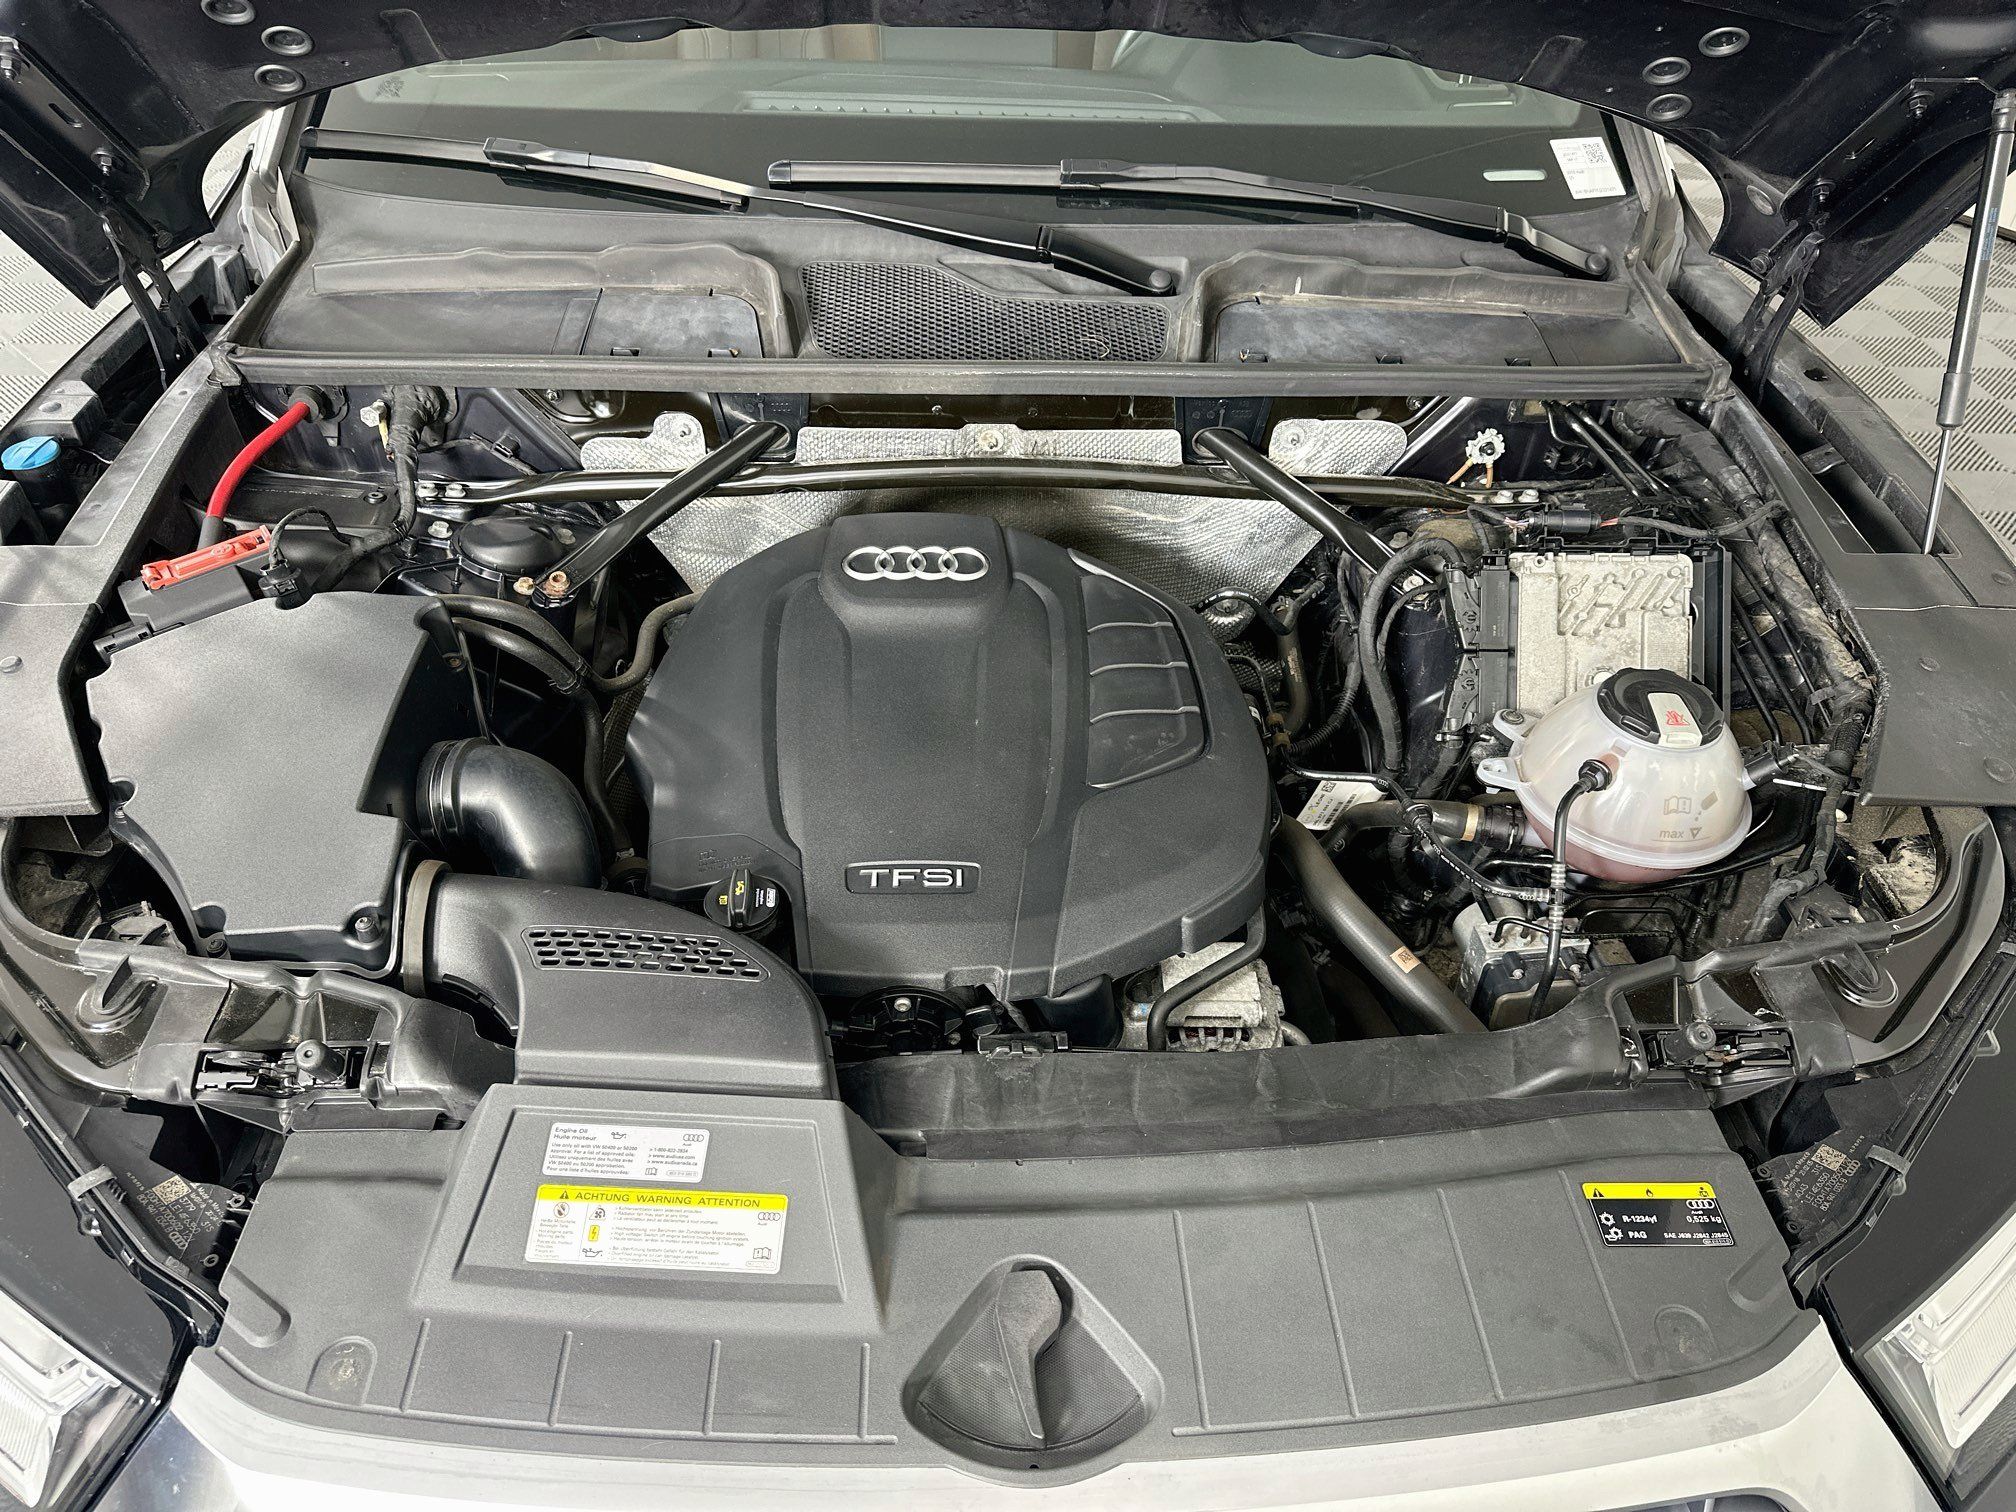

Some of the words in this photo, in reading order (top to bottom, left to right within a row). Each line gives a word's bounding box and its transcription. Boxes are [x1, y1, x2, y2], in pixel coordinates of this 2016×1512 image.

[1659, 829, 1684, 838] max
[859, 868, 964, 888] TFSI
[575, 1192, 630, 1202] ACHTUNG
[636, 1195, 692, 1204] WARNING
[698, 1197, 760, 1208] ATTENTION
[1622, 1215, 1658, 1224] R-1234yf
[1710, 1216, 1722, 1224] kg
[1628, 1231, 1647, 1239] PAG
